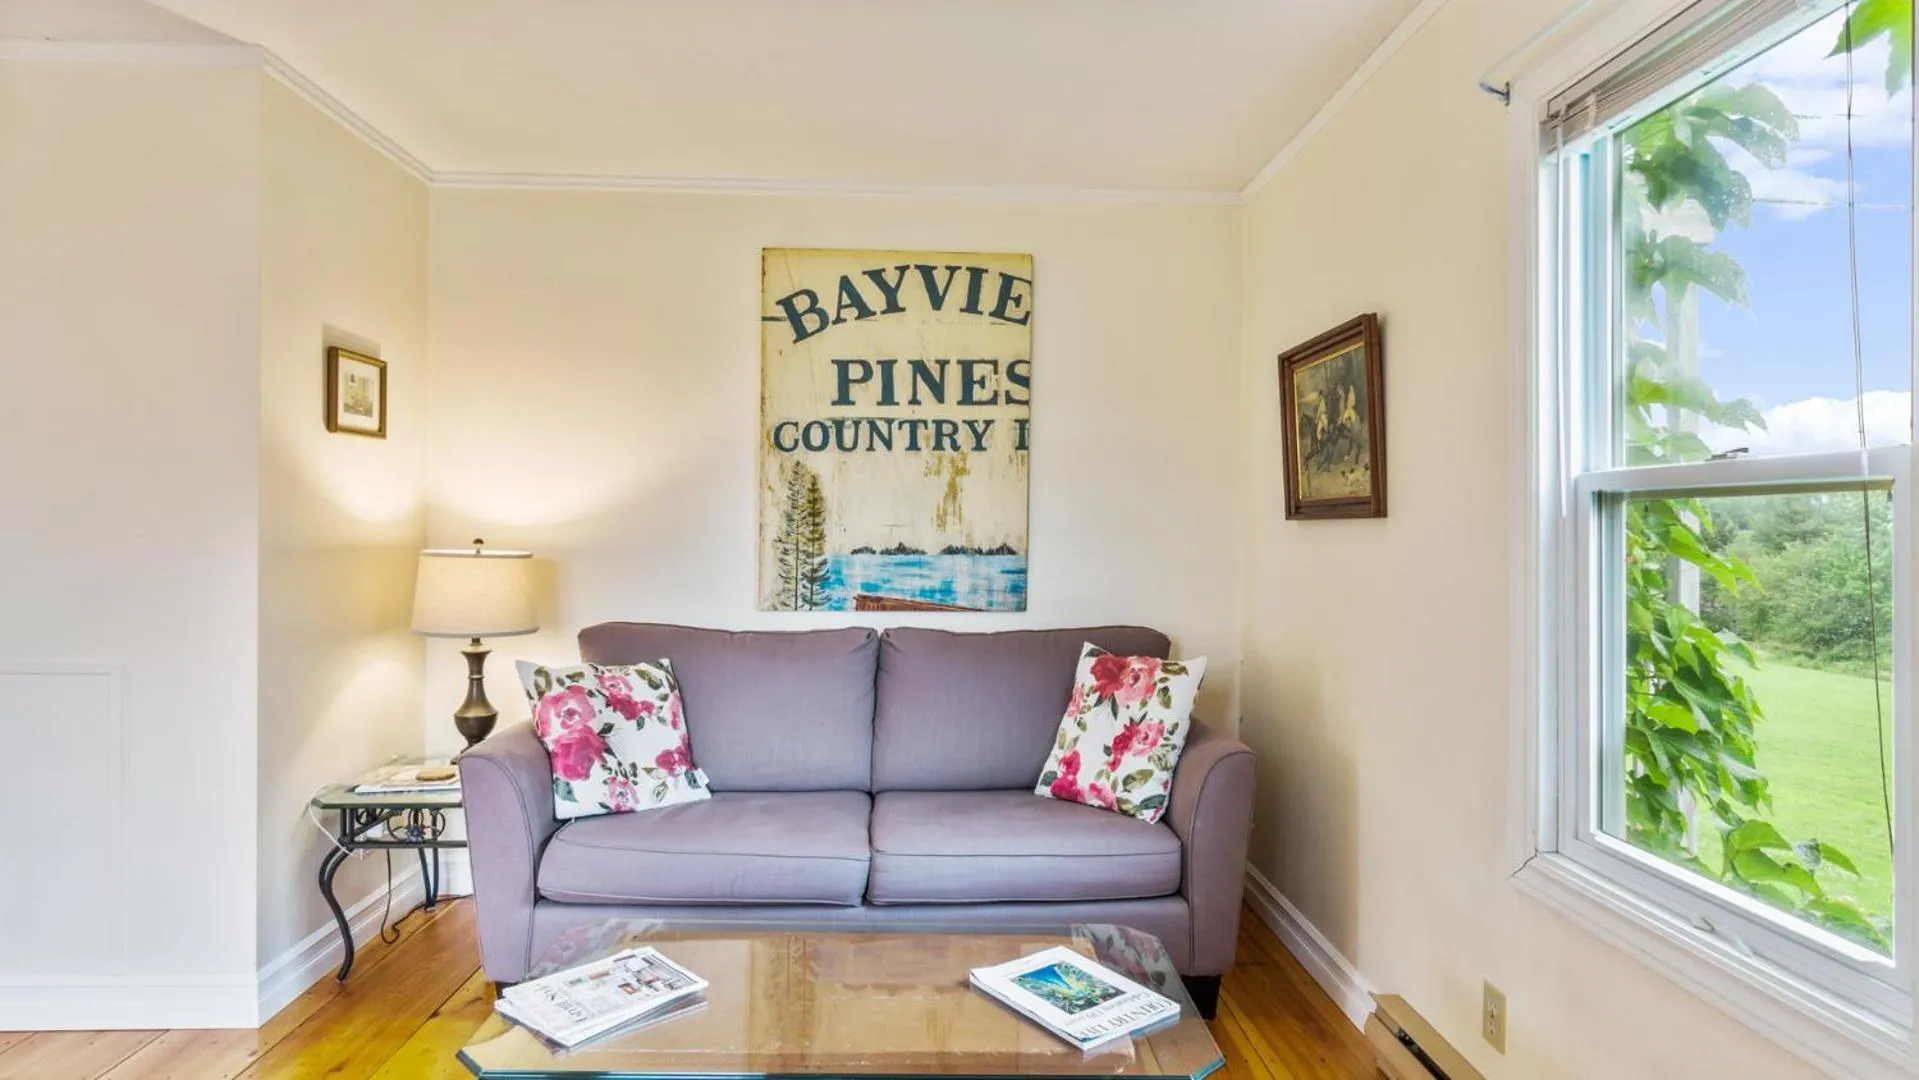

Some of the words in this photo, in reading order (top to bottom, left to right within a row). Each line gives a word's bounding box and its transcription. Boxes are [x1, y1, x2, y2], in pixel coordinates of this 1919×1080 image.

[776, 264, 1031, 344] BAYVIE
[831, 358, 1030, 406] PINES
[773, 419, 993, 453] COUNTRY
